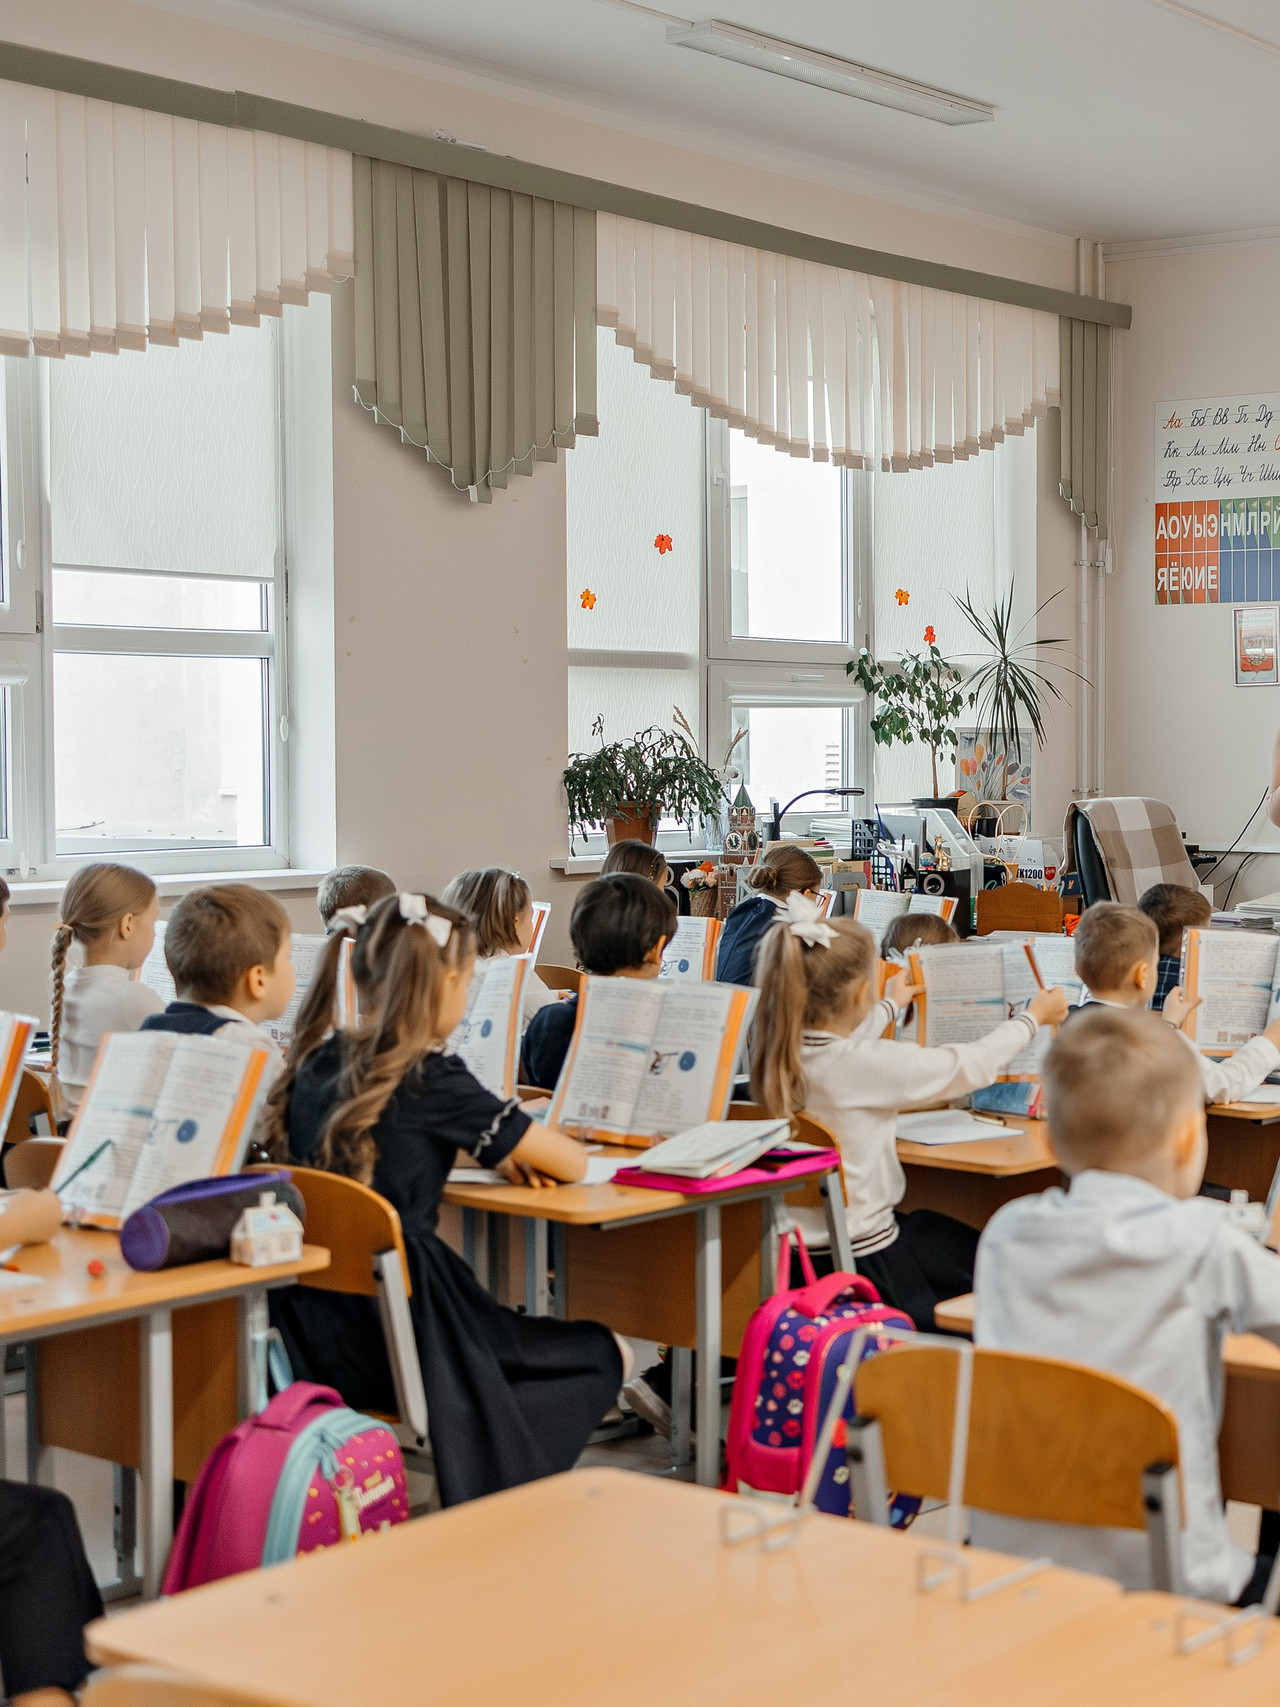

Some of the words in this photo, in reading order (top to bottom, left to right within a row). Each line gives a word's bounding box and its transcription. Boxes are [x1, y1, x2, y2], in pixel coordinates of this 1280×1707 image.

[1163, 411, 1183, 429] Аа
[1191, 408, 1212, 426] Бб
[1213, 408, 1230, 426] Вв
[1235, 405, 1249, 424] Гг
[1256, 404, 1273, 428] Дд
[1164, 441, 1180, 458] Кк
[1186, 438, 1207, 456] Лл
[1212, 437, 1240, 454] Мм
[1248, 434, 1266, 452] Нн
[1163, 470, 1182, 493] Фф
[1186, 468, 1208, 485] Хх
[1213, 466, 1232, 488] Цц
[1239, 466, 1254, 482] Чч
